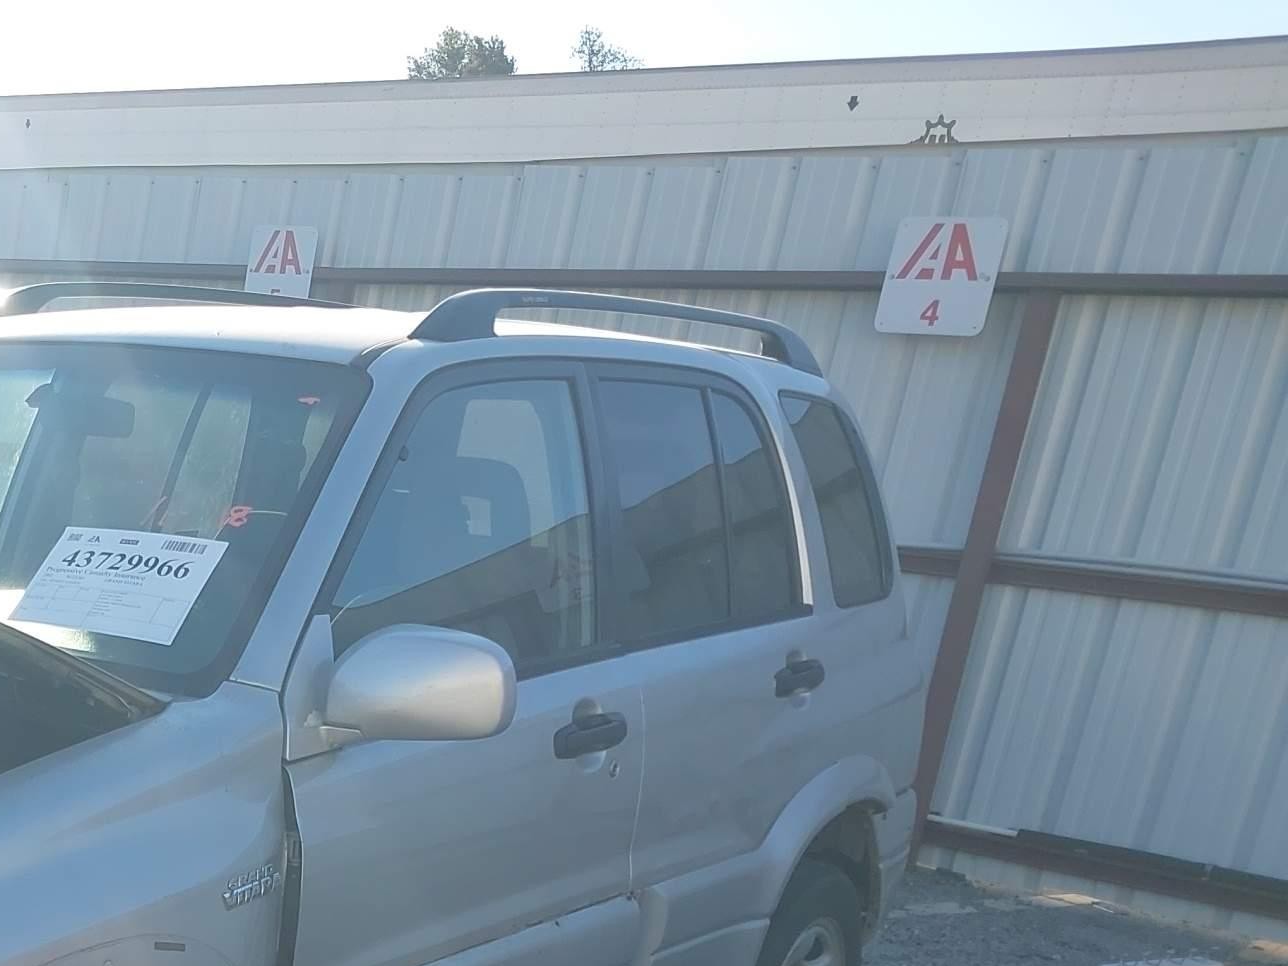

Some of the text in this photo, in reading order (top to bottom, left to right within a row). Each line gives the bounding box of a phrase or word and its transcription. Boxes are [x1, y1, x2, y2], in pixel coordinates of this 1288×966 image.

[253, 229, 302, 275] IAA
[895, 222, 978, 281] IAA
[919, 299, 940, 327] 4
[61, 549, 195, 580] 43729966
